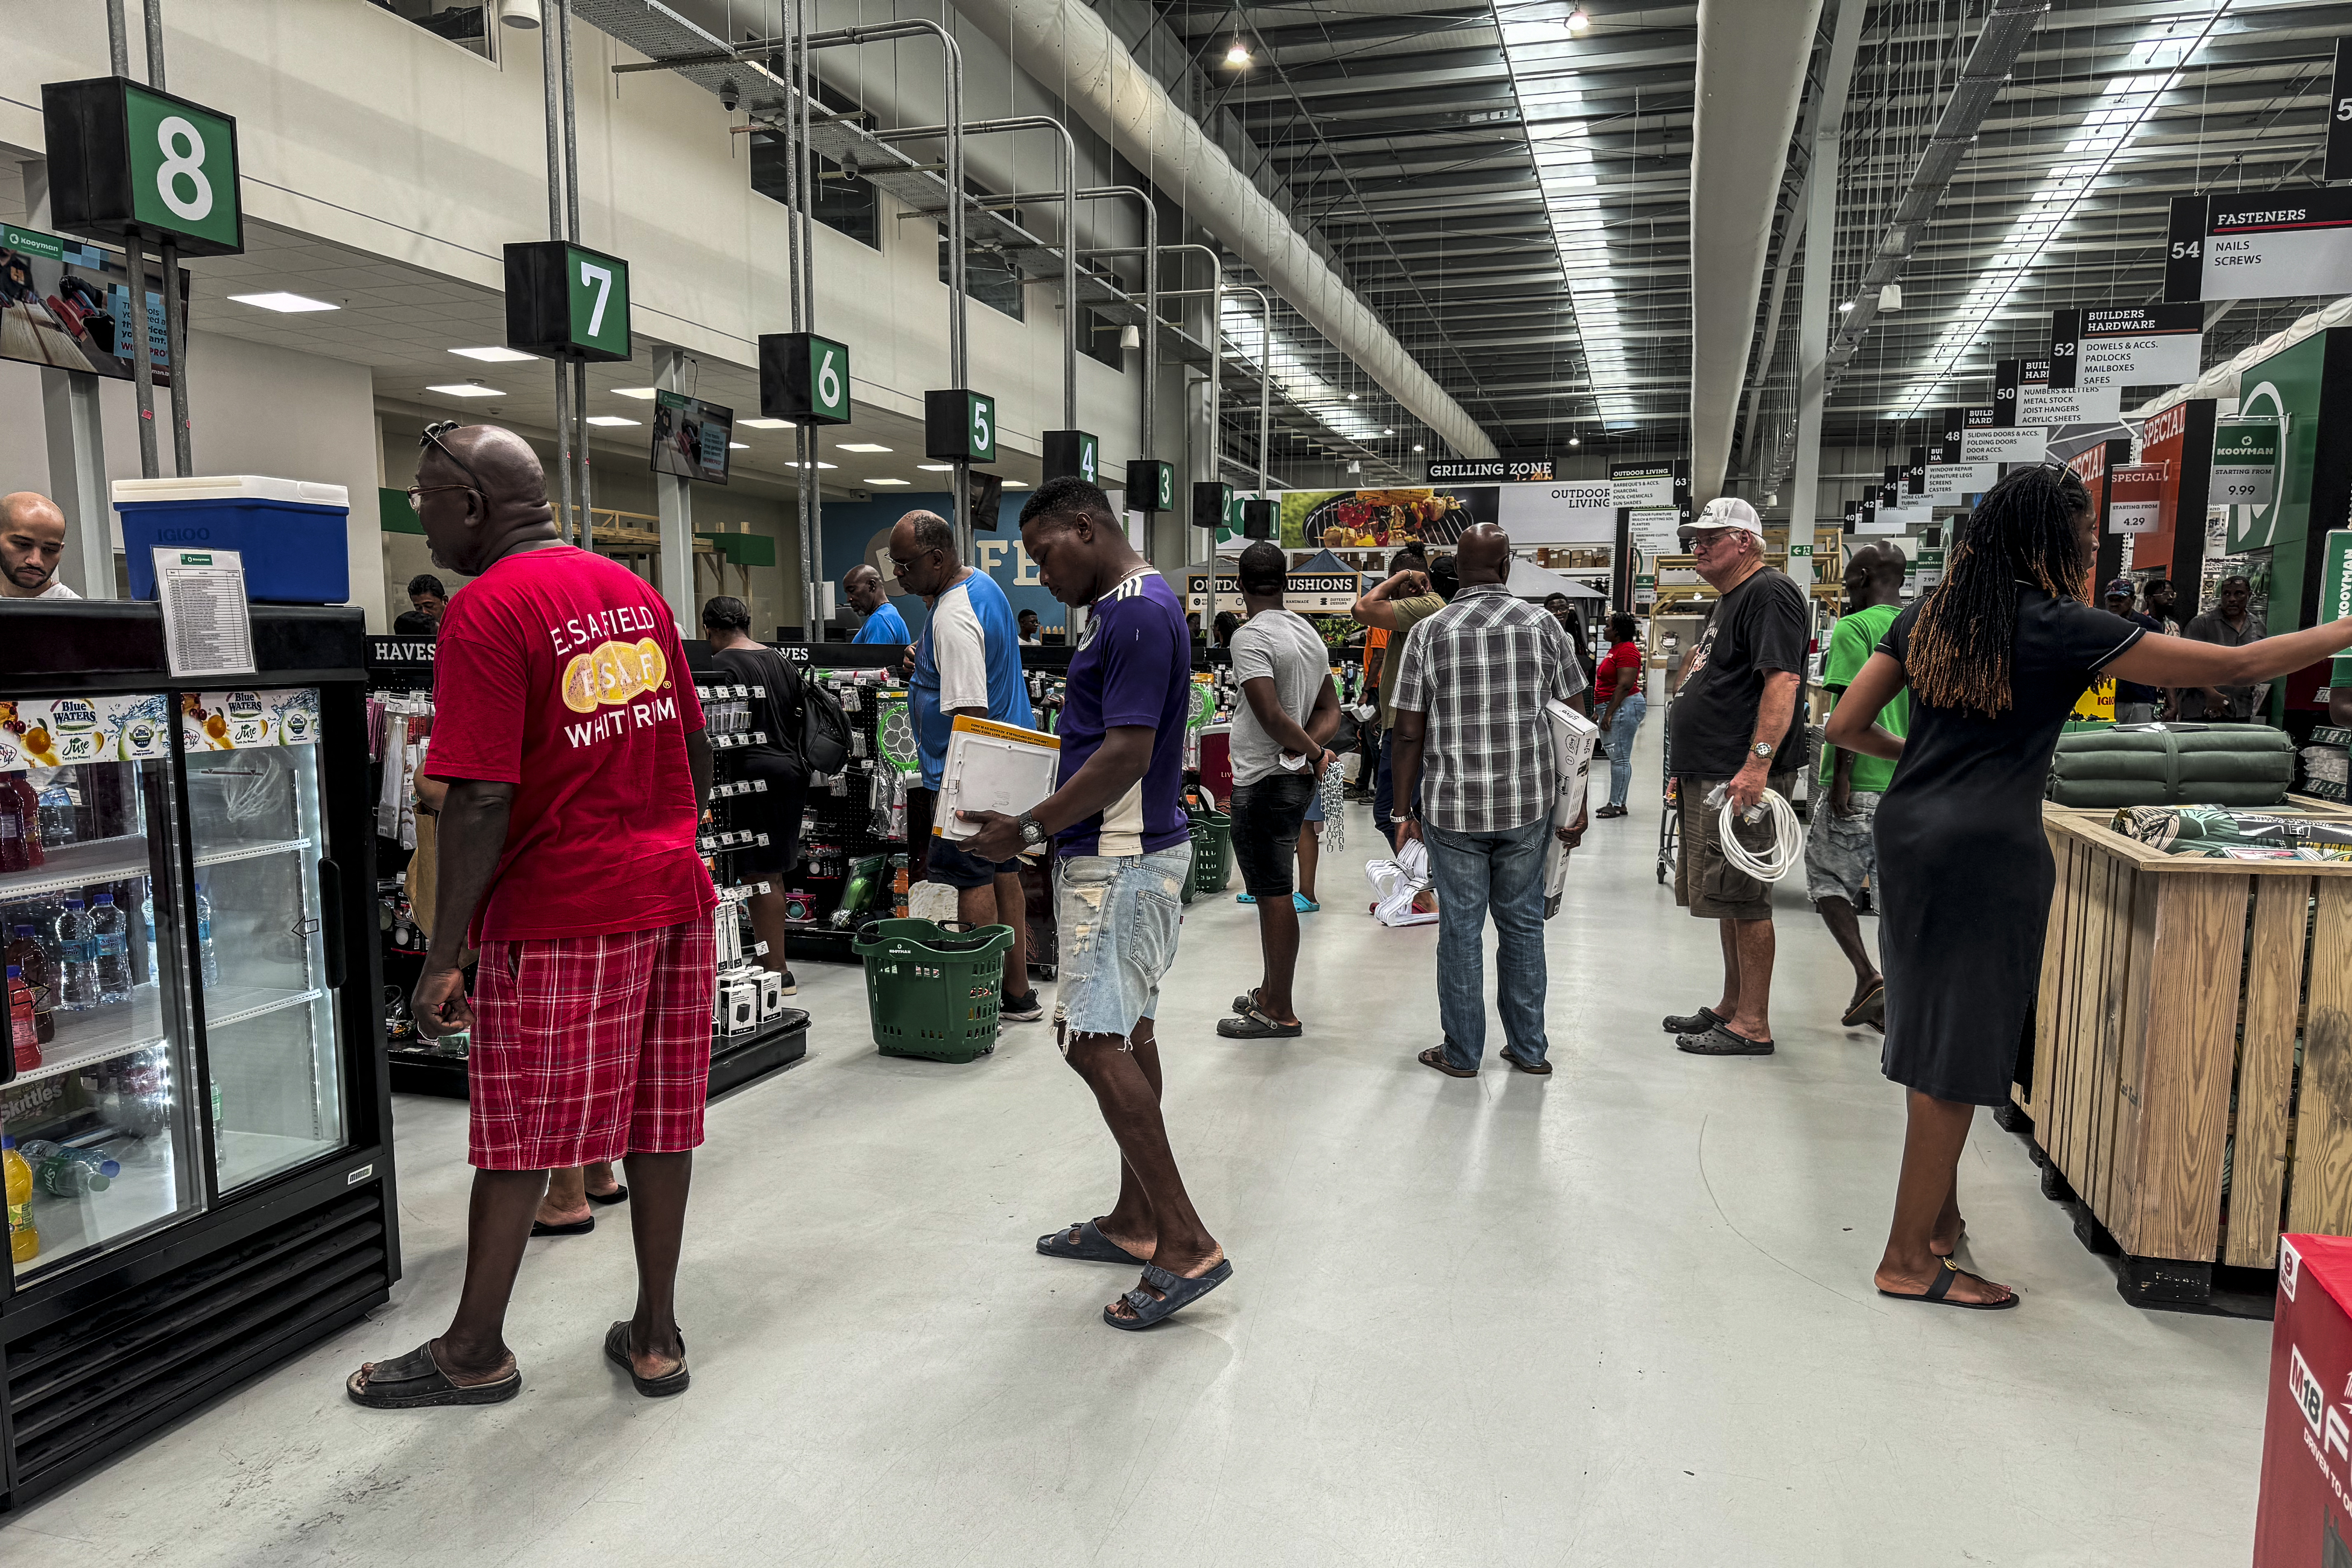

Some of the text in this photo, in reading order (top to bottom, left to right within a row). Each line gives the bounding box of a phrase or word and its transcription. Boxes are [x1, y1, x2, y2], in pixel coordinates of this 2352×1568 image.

[157, 116, 213, 221] 8
[2218, 209, 2306, 226] FASTENERS
[21, 237, 58, 252] Kooyman
[2171, 242, 2200, 259] 54
[2216, 241, 2250, 251] NAILS
[2214, 254, 2262, 266] SCREWS
[581, 261, 612, 337] 7
[2088, 309, 2145, 321] BUILDERS
[2088, 320, 2155, 332] HARDWARE
[2053, 343, 2075, 356] 52
[2086, 343, 2123, 351] DOWELS
[2085, 353, 2131, 362] PADLOCKS
[2084, 364, 2135, 373] MAILBOXES
[818, 350, 840, 408] 6
[1996, 388, 2015, 400] 50
[2044, 405, 2079, 414] HANGERS
[974, 402, 988, 451] 5
[2143, 406, 2185, 450] SPECIAL
[1945, 431, 1959, 441] 48
[1082, 442, 1094, 482] 4
[1430, 462, 1552, 477] GRILLING ZONE
[1910, 467, 1923, 476] 46
[2111, 472, 2162, 482] SPECIAL
[1161, 468, 1171, 504] 3
[2228, 485, 2256, 496] 9.99
[1551, 488, 1610, 499] OUTDOOR
[1223, 490, 1230, 522] 2
[1568, 499, 1610, 508] LIVING
[1271, 506, 1277, 534] 1
[2123, 517, 2145, 526] 4.29
[157, 528, 210, 542] IGLOO
[1288, 578, 1352, 591] USHIONS
[375, 643, 436, 661] HAVES
[778, 648, 809, 660] VES
[235, 693, 254, 701] Blue
[62, 701, 86, 712] Blue
[229, 701, 262, 712] WATERS
[53, 711, 96, 724] WATERS
[0, 1086, 62, 1123] Skittles
[2284, 1251, 2292, 1277] 9
[2293, 1353, 2320, 1424] M18
[2304, 1427, 2342, 1495] DRIVEN TO
